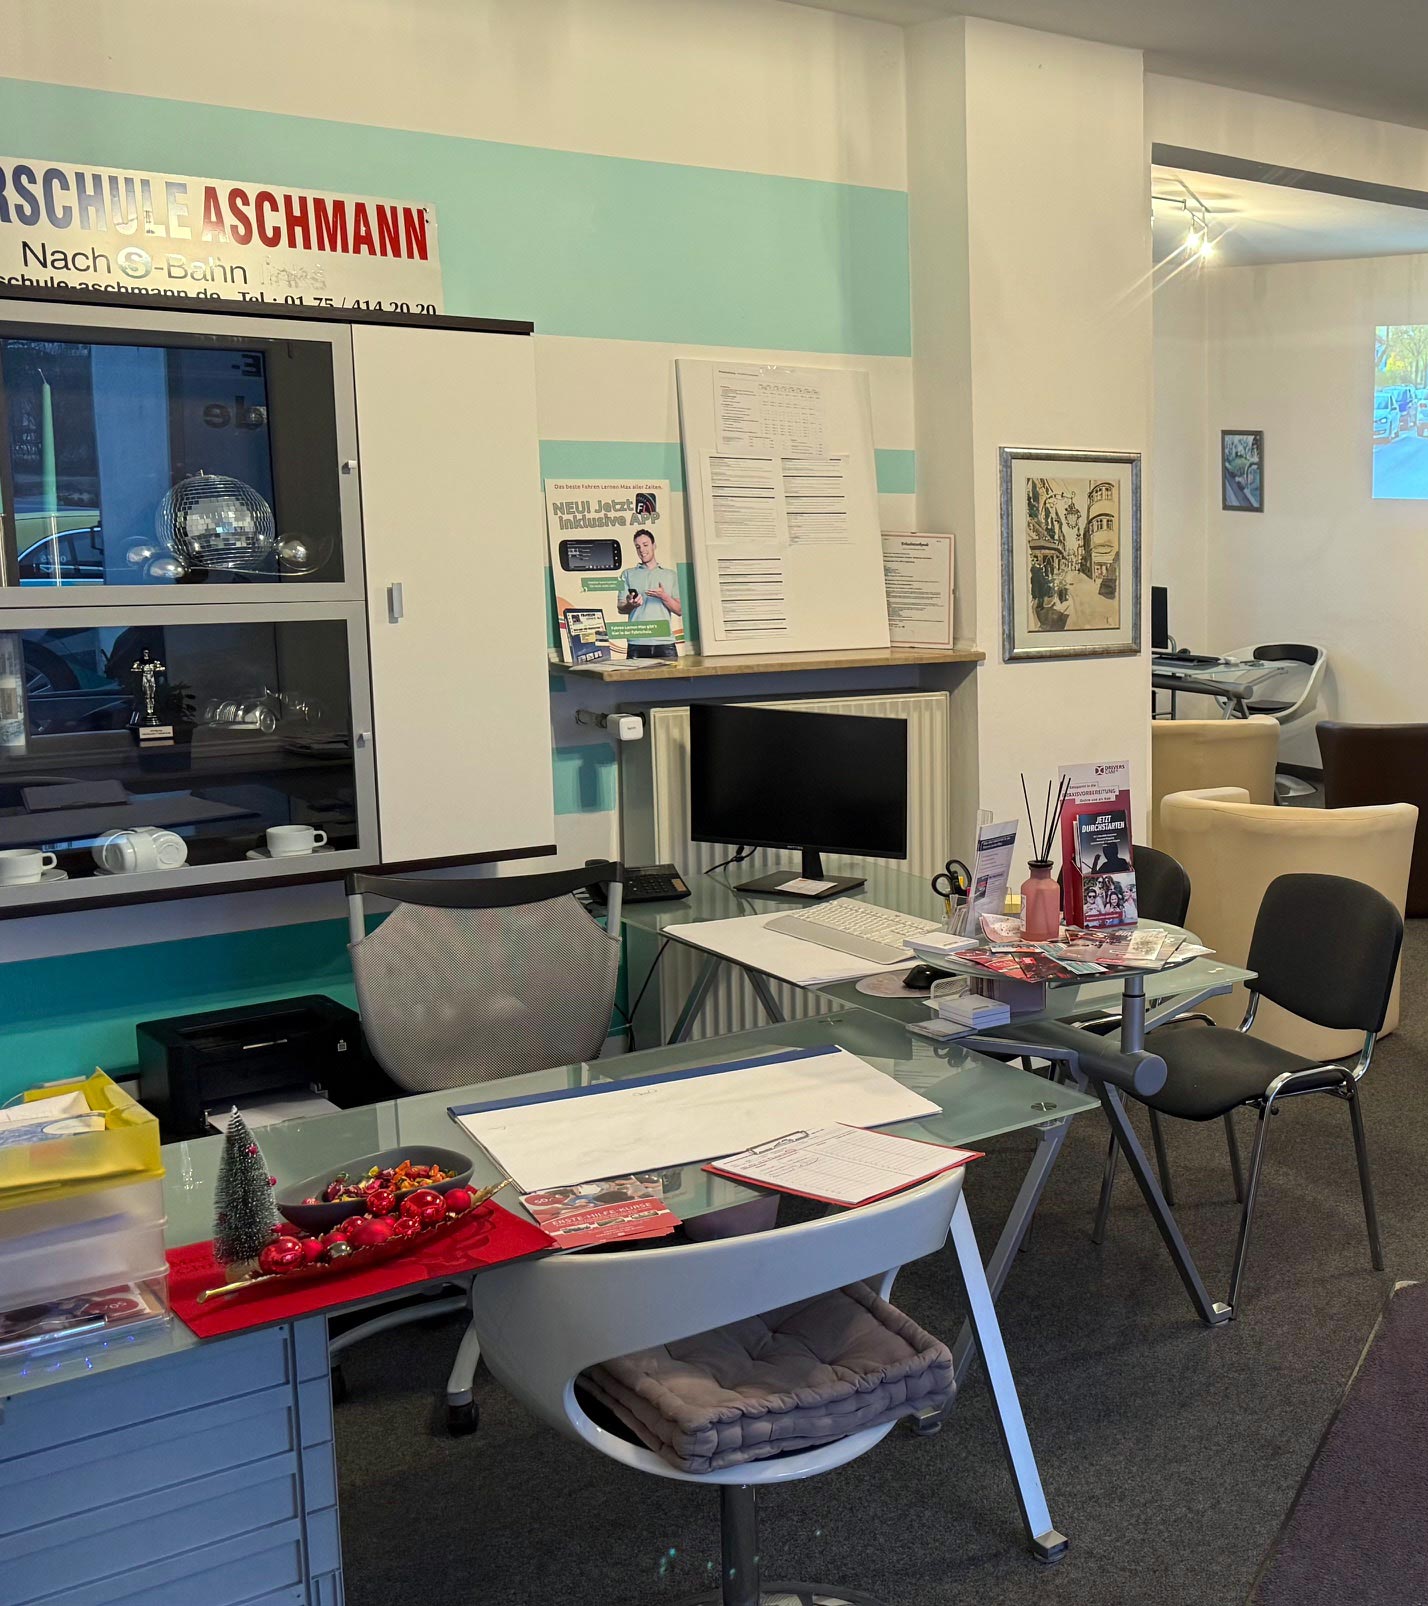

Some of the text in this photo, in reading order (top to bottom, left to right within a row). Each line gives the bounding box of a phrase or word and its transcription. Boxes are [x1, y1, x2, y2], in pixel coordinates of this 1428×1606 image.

[201, 185, 429, 261] ASCHMANN
[22, 240, 112, 274] Nach
[552, 499, 635, 516] NEU! Jetzt
[558, 511, 661, 530] inklusive APP
[1081, 821, 1125, 833] DURCHSTARTEN
[1096, 815, 1112, 824] JETZT
[551, 1202, 653, 1227] ERSTE-HILFE-KURSE
